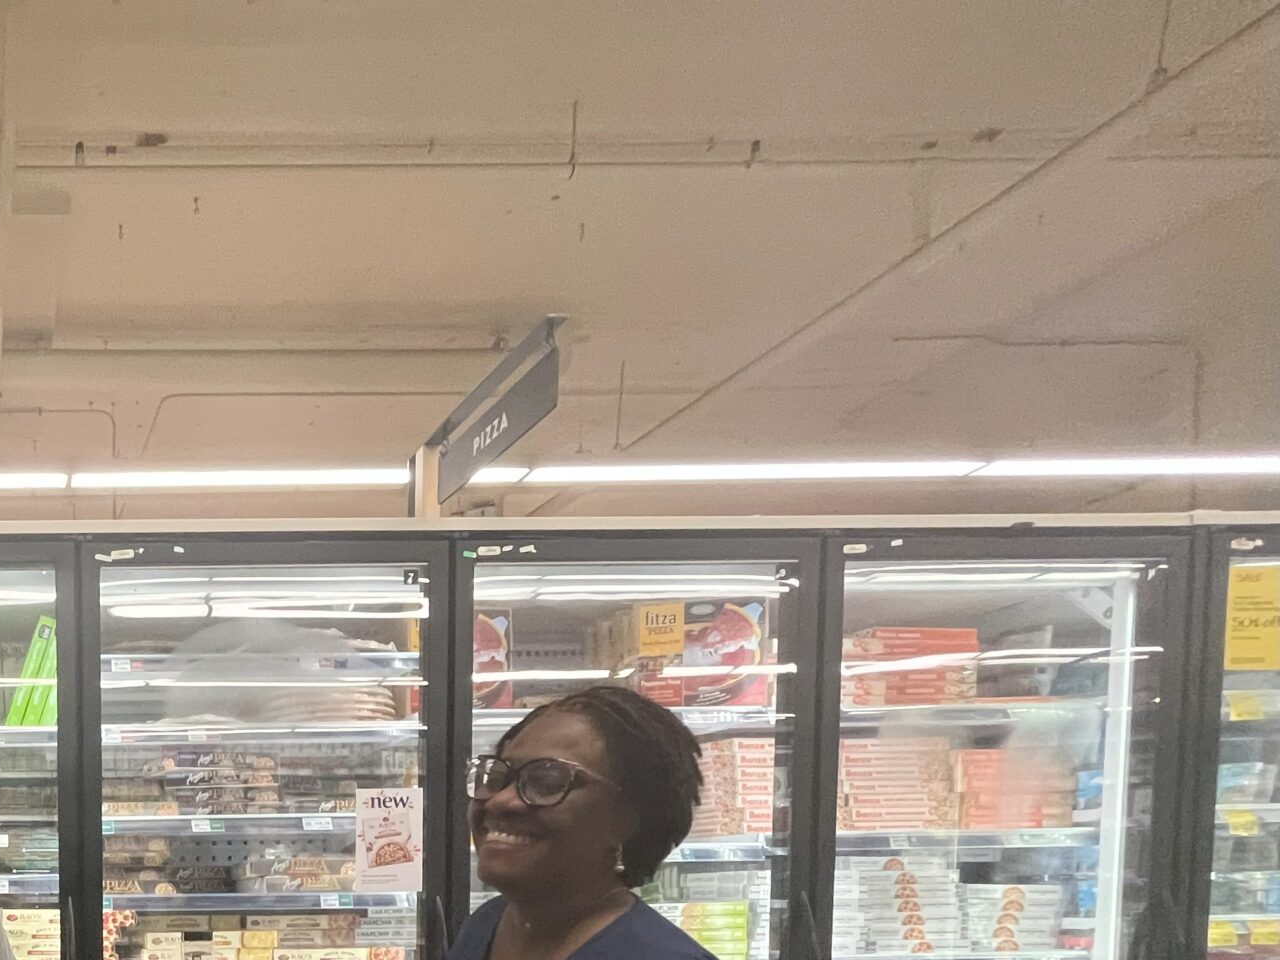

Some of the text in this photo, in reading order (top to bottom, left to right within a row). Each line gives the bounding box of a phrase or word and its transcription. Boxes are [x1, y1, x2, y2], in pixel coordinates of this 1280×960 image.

[472, 412, 509, 456] PIZZA
[336, 799, 355, 809] PIZ
[370, 796, 410, 809] new
